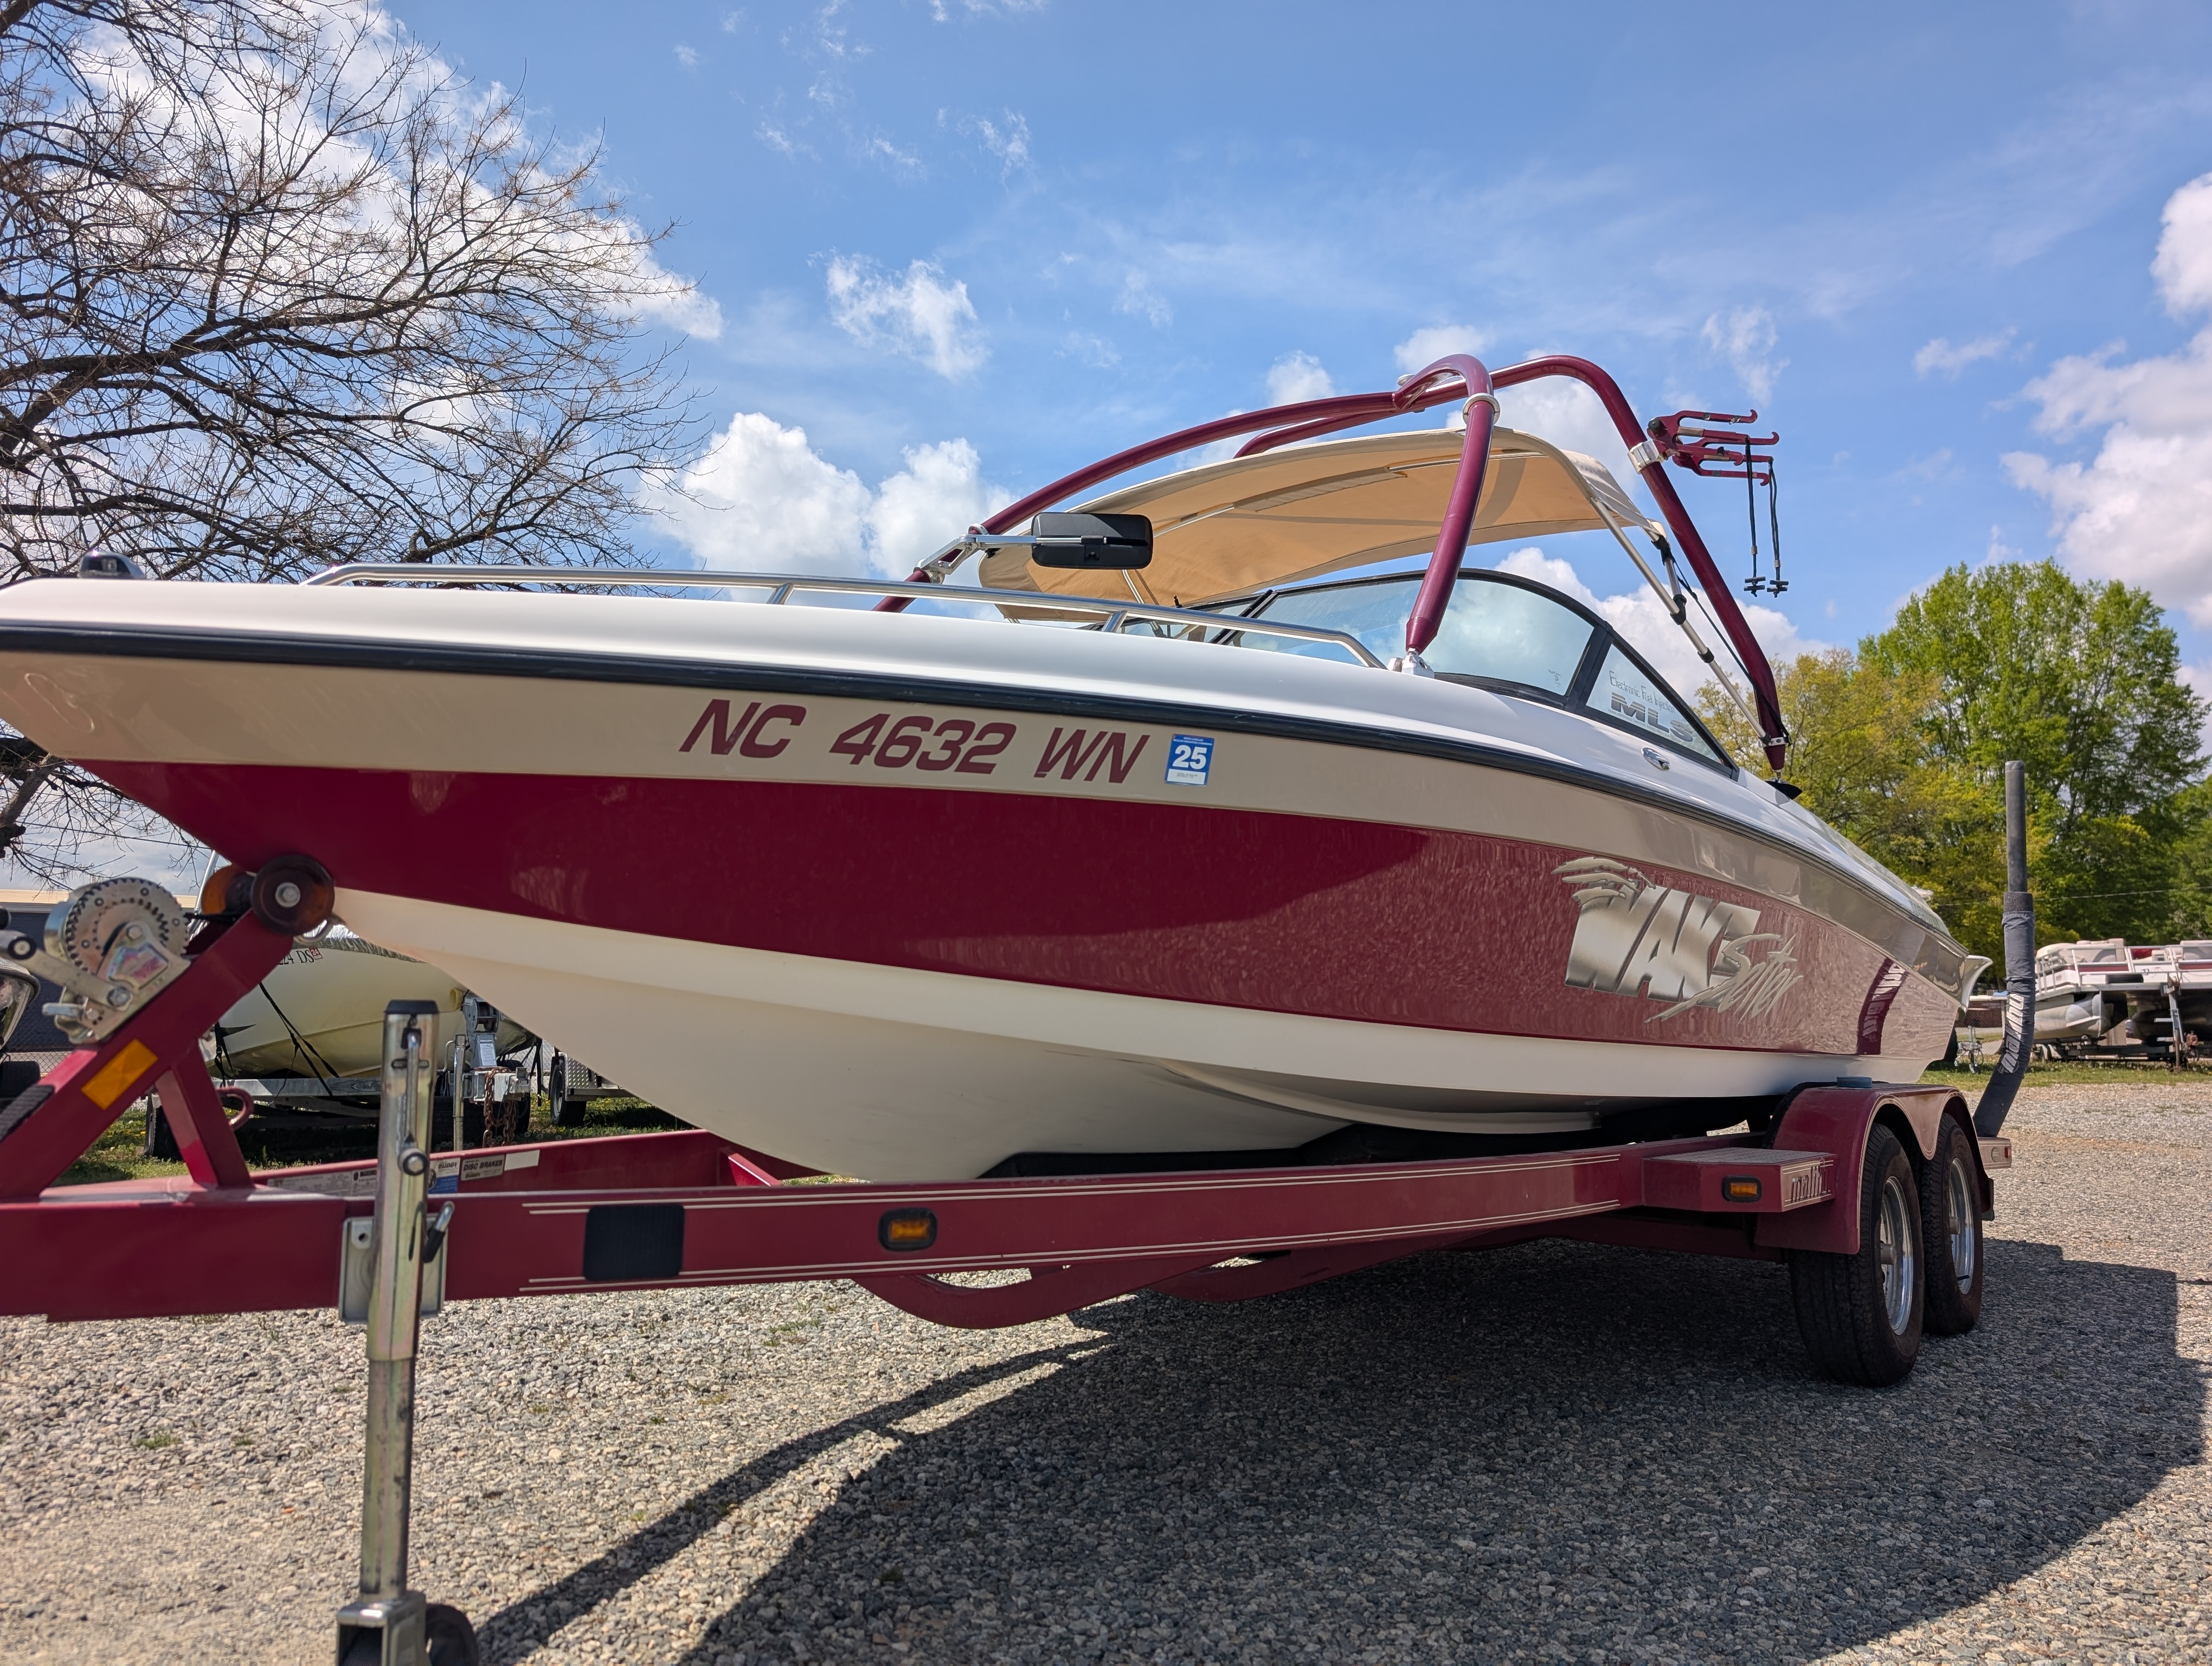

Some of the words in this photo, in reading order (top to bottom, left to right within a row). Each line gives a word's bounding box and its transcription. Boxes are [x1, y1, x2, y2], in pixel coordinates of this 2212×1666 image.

[1609, 670, 1640, 698] Electronic
[1641, 685, 1652, 703] Fuel
[1654, 691, 1675, 714] Injection
[1611, 691, 1693, 742] MLS
[680, 700, 807, 758] NC
[829, 714, 1015, 774] 4632
[1033, 728, 1149, 783] WN
[1172, 745, 1206, 770] 25
[295, 950, 314, 963] DS
[464, 1163, 478, 1171] DISC
[479, 1159, 503, 1169] BRAKES
